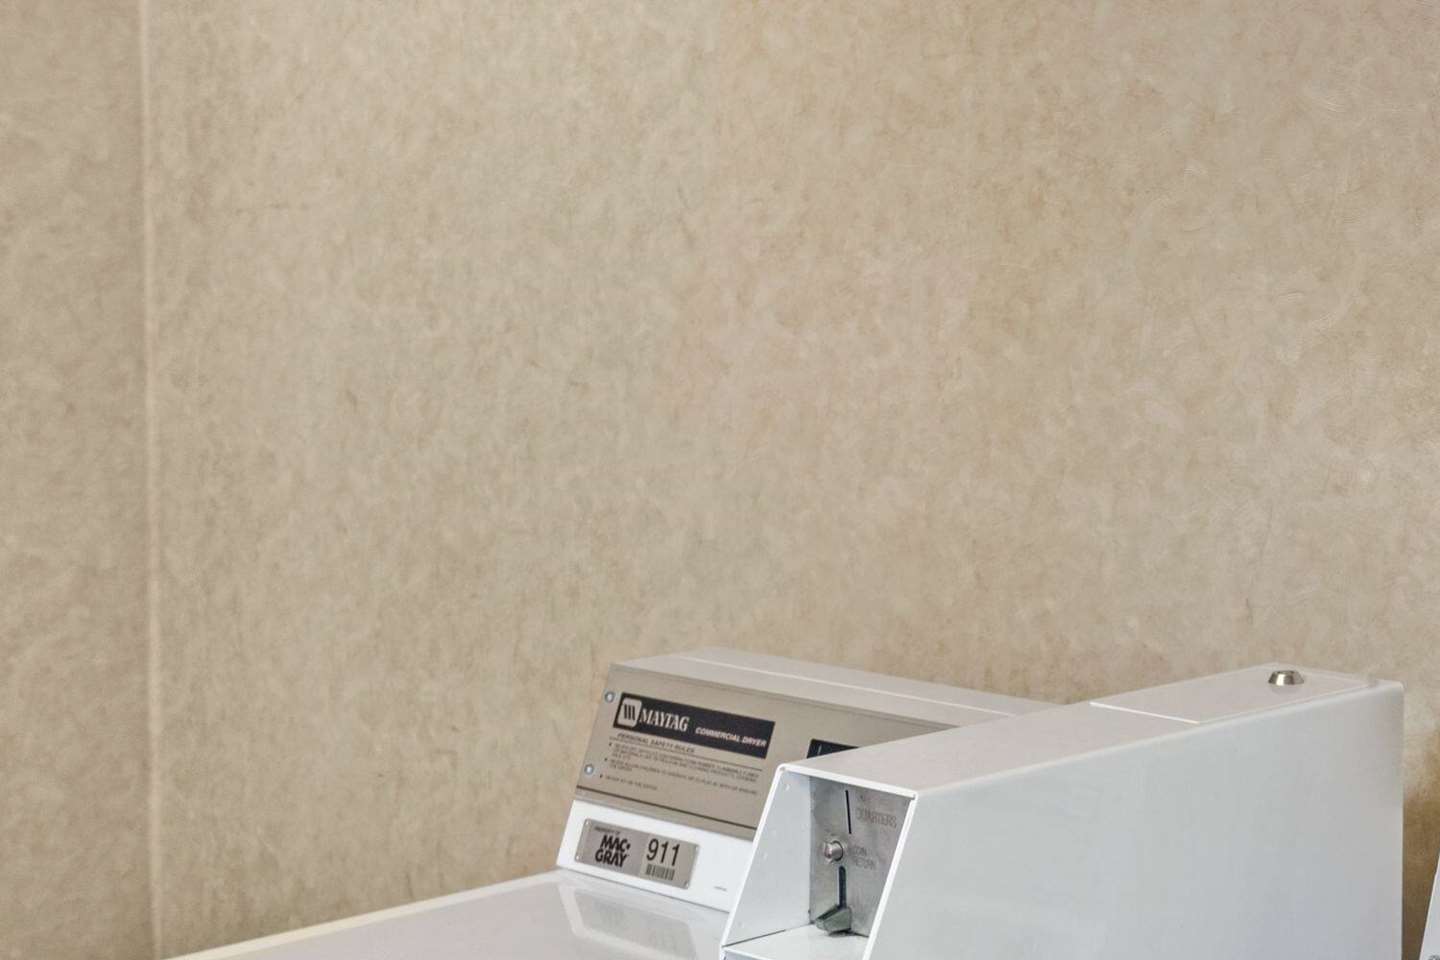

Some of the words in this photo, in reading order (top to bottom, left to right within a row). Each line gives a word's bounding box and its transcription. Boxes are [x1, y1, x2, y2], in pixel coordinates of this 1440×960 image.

[639, 708, 690, 732] MAYTAG
[695, 727, 740, 743] COMMERCIAL
[742, 736, 767, 747] DRYER
[595, 850, 628, 868] GRAY
[646, 838, 680, 866] 911
